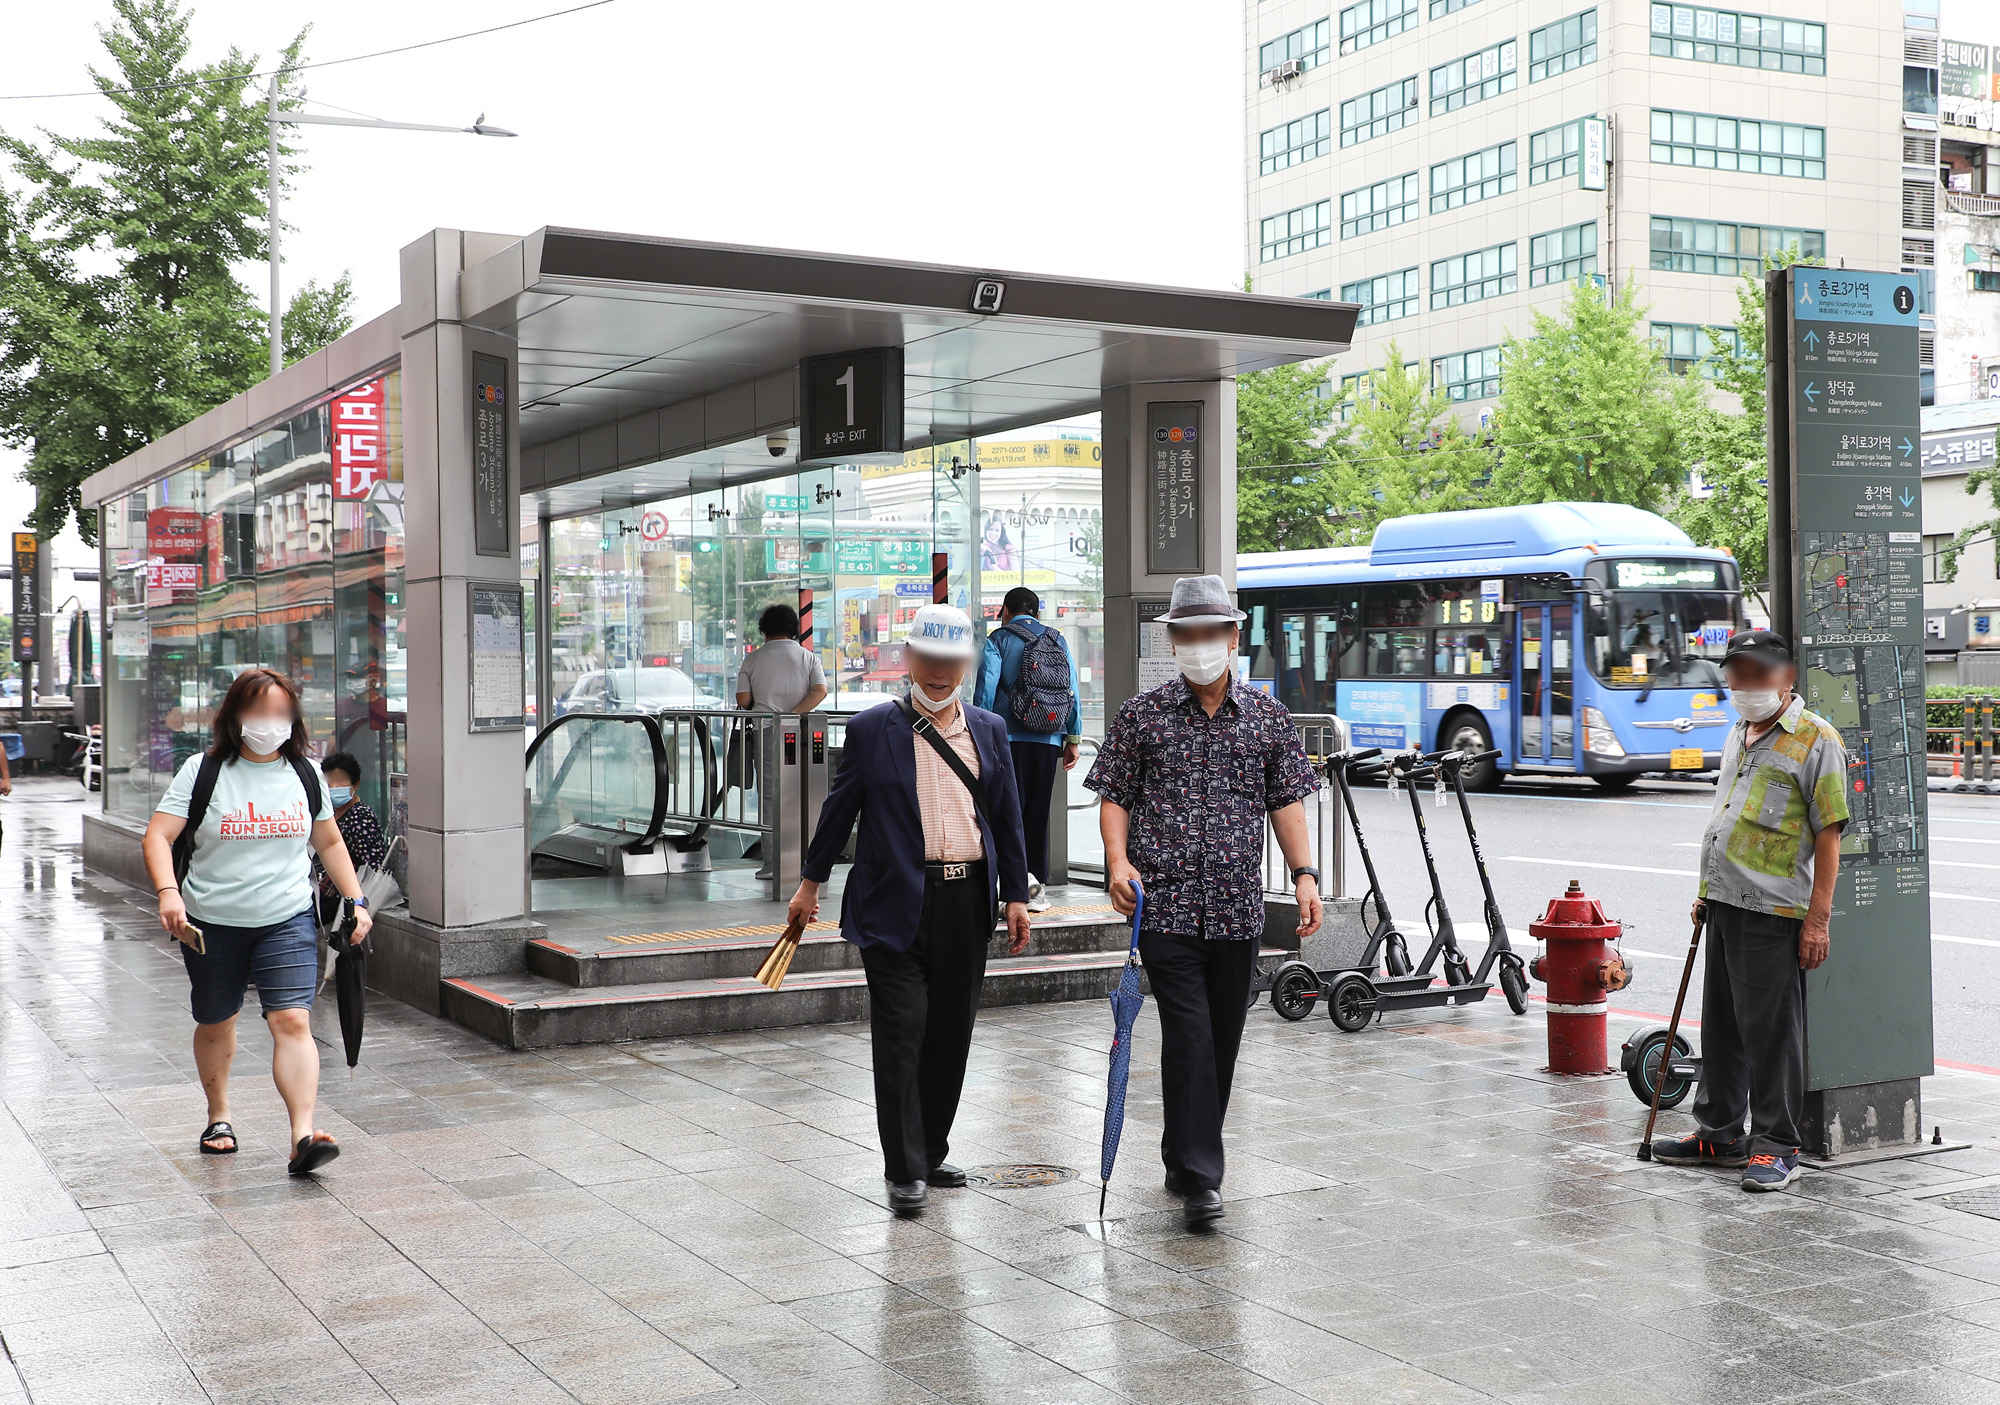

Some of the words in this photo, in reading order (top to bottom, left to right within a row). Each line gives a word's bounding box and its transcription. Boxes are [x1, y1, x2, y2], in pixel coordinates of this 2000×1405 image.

[1818, 279, 1870, 300] 종로3가역
[1827, 330, 1870, 348] 종로5가역
[1827, 348, 1845, 356] Jongno
[836, 365, 854, 427] 1
[1827, 380, 1856, 396] 창덕궁
[1828, 398, 1868, 408] Changdeokgung
[1867, 400, 1883, 408] Palace
[824, 431, 846, 445] 출입구
[849, 428, 867, 441] EXIT
[1156, 431, 1168, 439] 130
[1184, 430, 1196, 438] 534
[1840, 434, 1891, 451] 을지로3가역
[478, 408, 490, 492] 종로3가
[1168, 449, 1178, 485] Jongno
[1178, 449, 1196, 519] 종로3가
[1864, 485, 1892, 501] 종각역
[1856, 503, 1876, 512] Jonggak
[838, 561, 873, 572] 종로4가
[1442, 599, 1496, 624] 150
[220, 823, 255, 835] RUN
[258, 821, 306, 835] SEOUL
